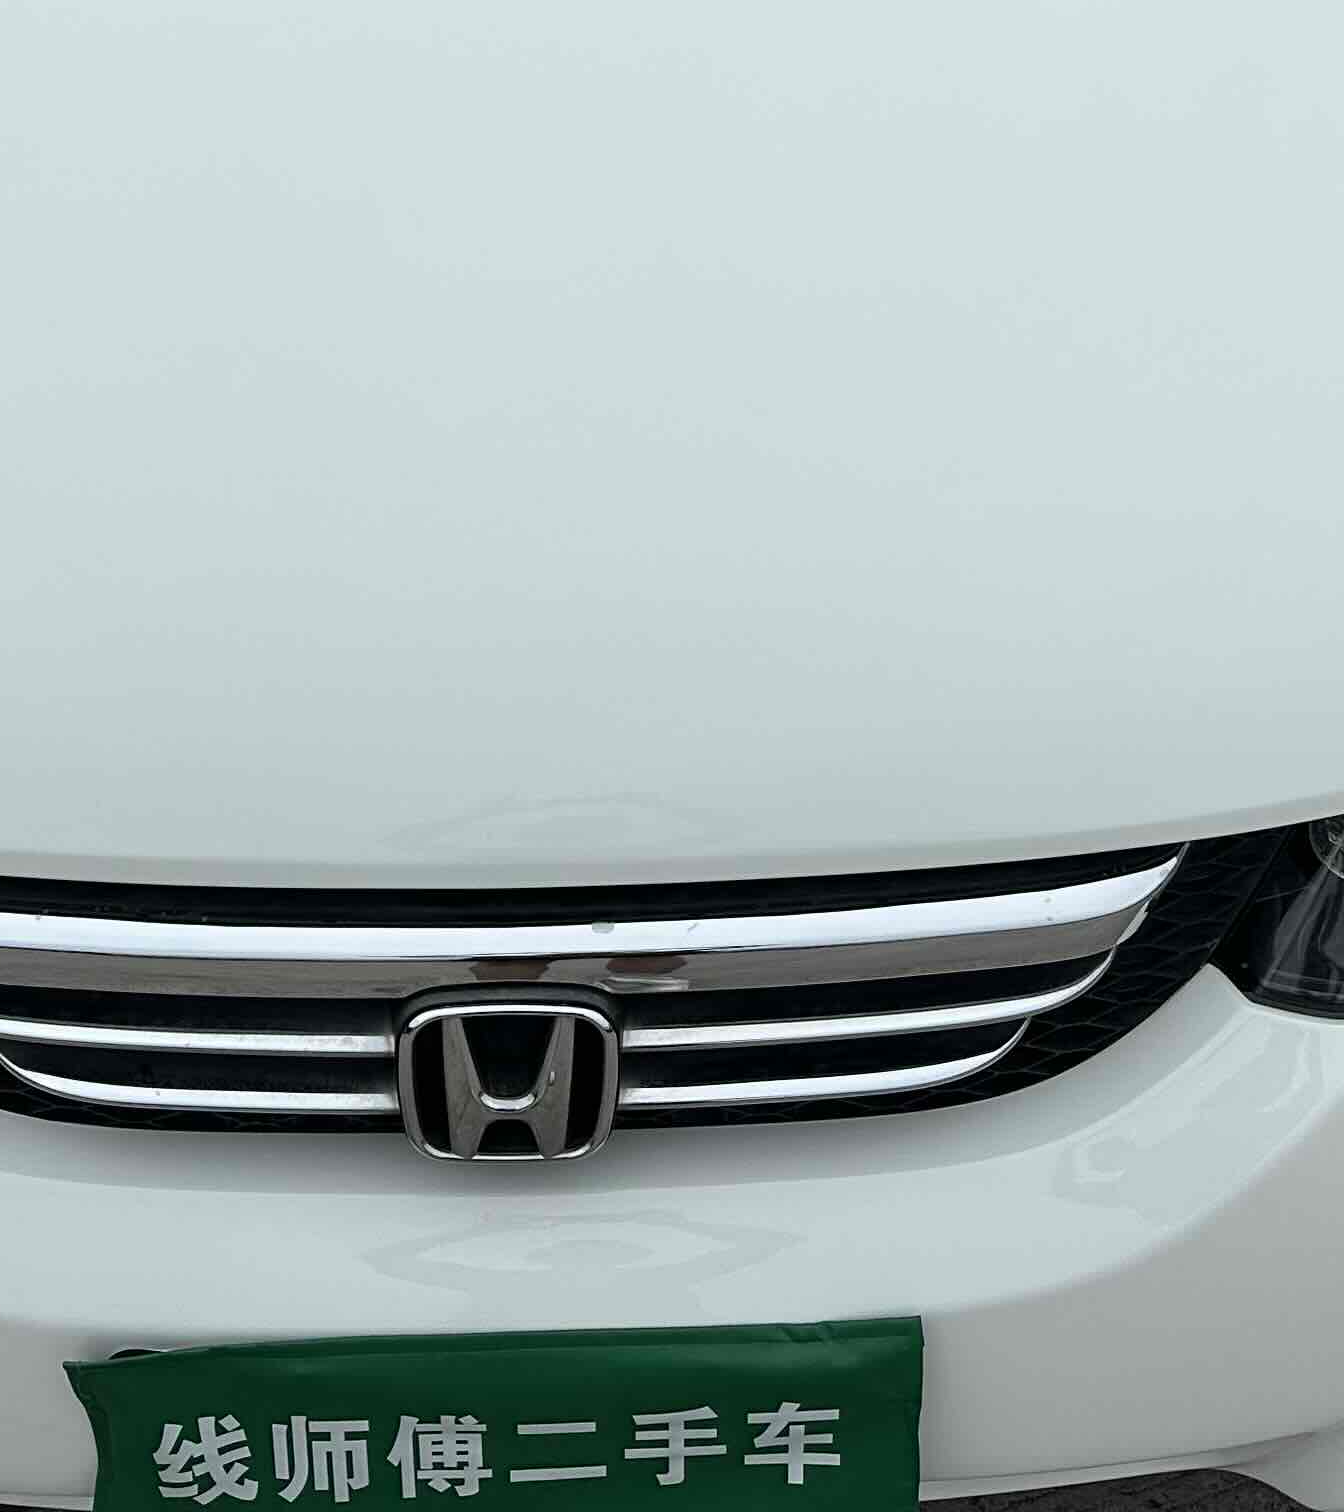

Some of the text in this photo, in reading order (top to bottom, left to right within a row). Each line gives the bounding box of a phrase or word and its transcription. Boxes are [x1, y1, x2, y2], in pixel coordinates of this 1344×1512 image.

[153, 1400, 842, 1505] 线师傅二手车
